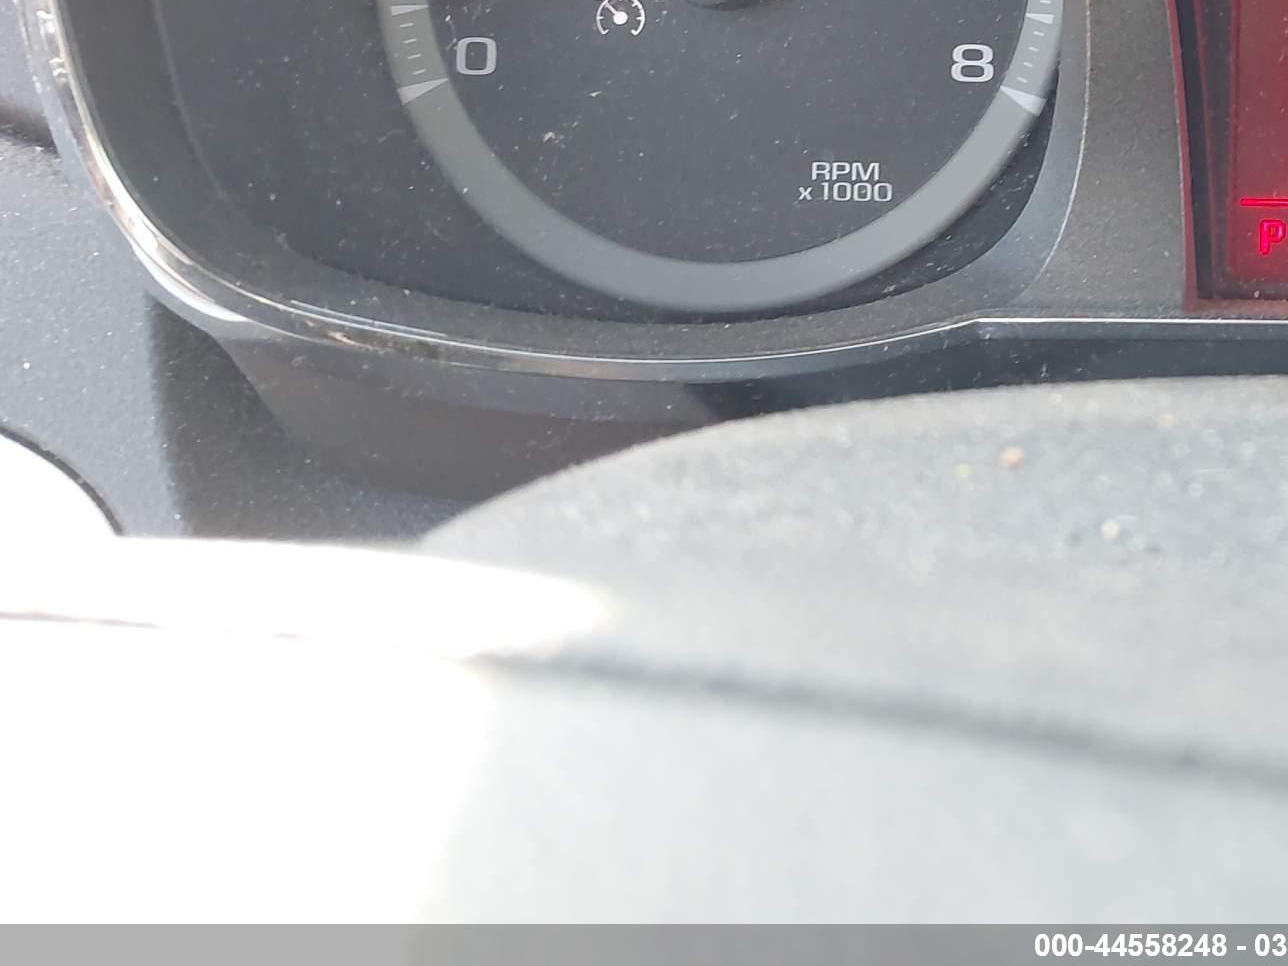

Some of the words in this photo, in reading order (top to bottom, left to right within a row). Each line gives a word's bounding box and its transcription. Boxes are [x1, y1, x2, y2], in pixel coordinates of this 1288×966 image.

[455, 37, 497, 75] 0
[951, 44, 993, 82] 8
[811, 161, 881, 182] RPM
[1258, 219, 1287, 256] P
